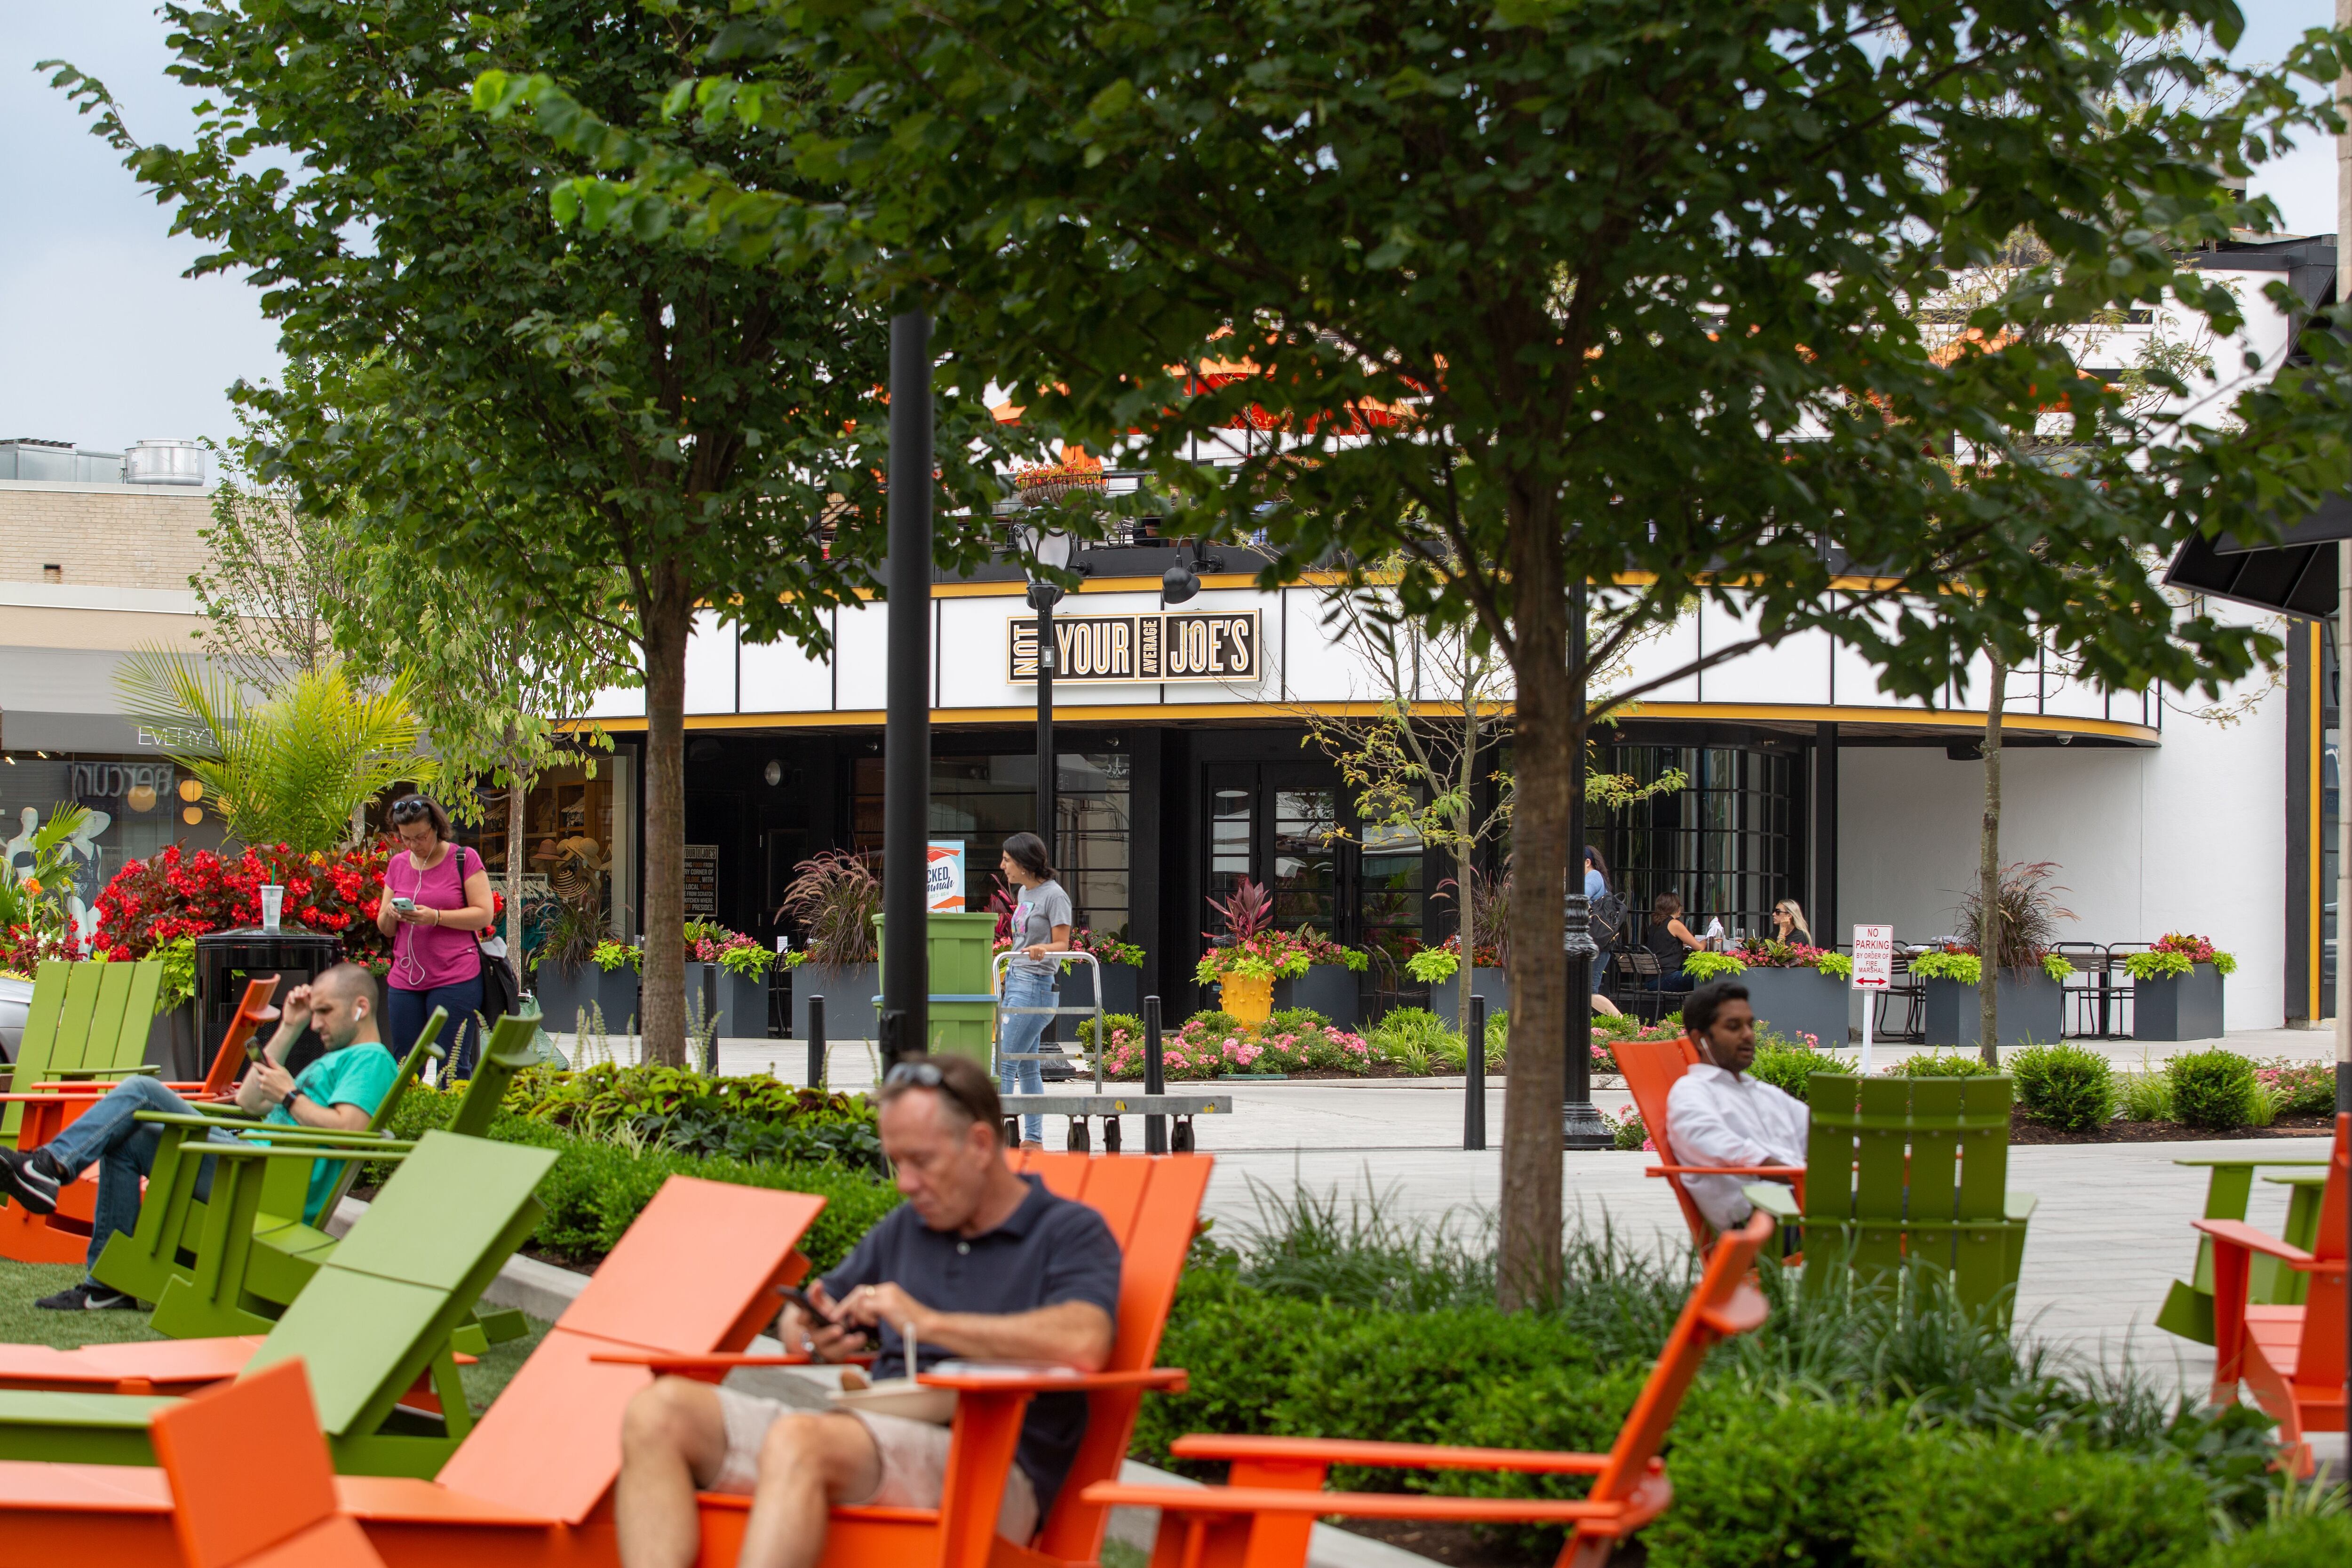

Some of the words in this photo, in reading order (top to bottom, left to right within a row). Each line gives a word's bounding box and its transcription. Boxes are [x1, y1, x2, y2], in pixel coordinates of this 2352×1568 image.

[1013, 625, 1038, 676] NOT
[1056, 622, 1130, 675] YOUR
[1143, 621, 1158, 673] AVERAGE
[1171, 619, 1249, 673] JOE'S
[702, 849, 715, 858] JOE'S
[927, 867, 948, 883] CKED
[1867, 928, 1878, 937] NO
[1856, 940, 1889, 949] PARKING
